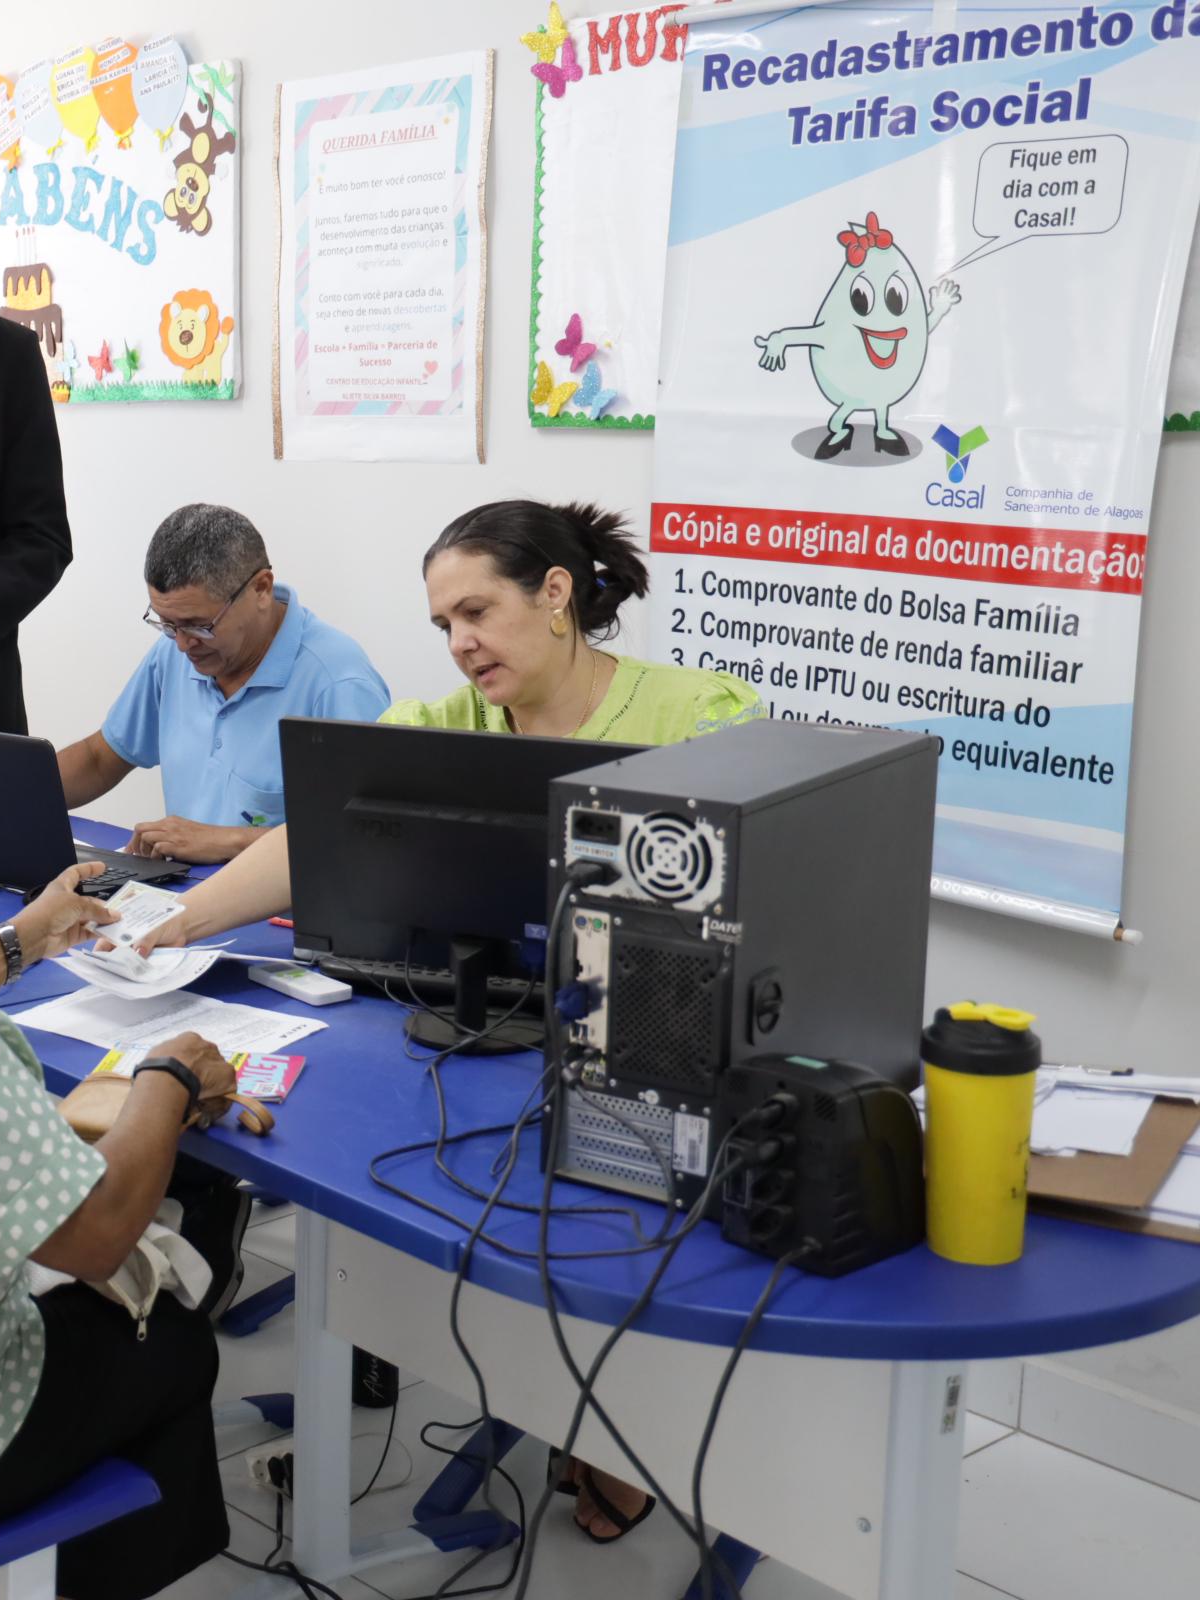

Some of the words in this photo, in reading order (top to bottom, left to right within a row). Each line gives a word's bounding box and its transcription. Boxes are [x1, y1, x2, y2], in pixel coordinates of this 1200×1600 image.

[702, 6, 1133, 92] Recadastramento
[788, 96, 916, 145] Tarifa
[930, 77, 1092, 133] Social
[321, 131, 378, 154] QUERIDA
[381, 124, 436, 144] FAMÍLIA
[1009, 148, 1063, 171] Fique
[1068, 148, 1097, 164] em
[325, 181, 349, 193] muito
[351, 179, 370, 191] bom
[371, 177, 384, 188] ter
[385, 174, 405, 187] você
[407, 170, 448, 184] conosco!
[1002, 179, 1032, 198] dia
[1038, 180, 1079, 197] com
[1084, 178, 1096, 194] a
[343, 211, 379, 223] faremos
[380, 208, 400, 219] tudo
[401, 208, 421, 220] para
[422, 205, 440, 217] que
[441, 204, 448, 213] o
[1014, 207, 1077, 229] Casal!
[319, 227, 390, 241] desenvolvimento
[391, 223, 407, 235] das
[407, 221, 445, 234] crianças
[317, 245, 354, 257] aconteça
[355, 244, 374, 255] com
[374, 242, 399, 253] muita
[442, 238, 449, 247] e
[318, 293, 342, 304] Conto
[343, 291, 362, 302] com
[362, 289, 382, 300] você
[383, 289, 403, 301] para
[405, 287, 427, 298] cada
[315, 309, 332, 320] seja
[332, 307, 354, 318] cheio
[355, 306, 367, 316] de
[393, 303, 448, 315] descobertas
[313, 343, 340, 353] Escola
[386, 340, 424, 351] Parceria
[426, 339, 438, 350] de
[359, 357, 392, 368] Sucesso
[925, 482, 986, 509] Casal
[1005, 485, 1073, 501] Companhia
[1077, 489, 1094, 501] de
[1004, 500, 1080, 516] Saneamento
[1084, 504, 1100, 516] de
[1103, 506, 1144, 521] Alagoas
[663, 511, 738, 548] Cópia
[745, 522, 761, 547] e
[768, 520, 869, 558] original
[875, 527, 908, 559] da
[674, 568, 694, 594] 1.
[701, 570, 857, 610] Comprovante
[864, 586, 892, 615] do
[899, 589, 965, 625] Bolsa
[973, 598, 1080, 636] Família
[671, 608, 692, 634] 2.
[700, 611, 854, 653] Comprovante
[860, 630, 889, 660] de
[895, 640, 962, 670] renda
[970, 644, 1083, 684] familiar
[699, 651, 763, 684] Carnê
[770, 661, 798, 689] de
[805, 665, 856, 697] IPTU
[862, 679, 890, 703] ou
[897, 685, 1004, 722] escritura
[1014, 697, 1050, 728] do
[952, 737, 1114, 785] equivalente
